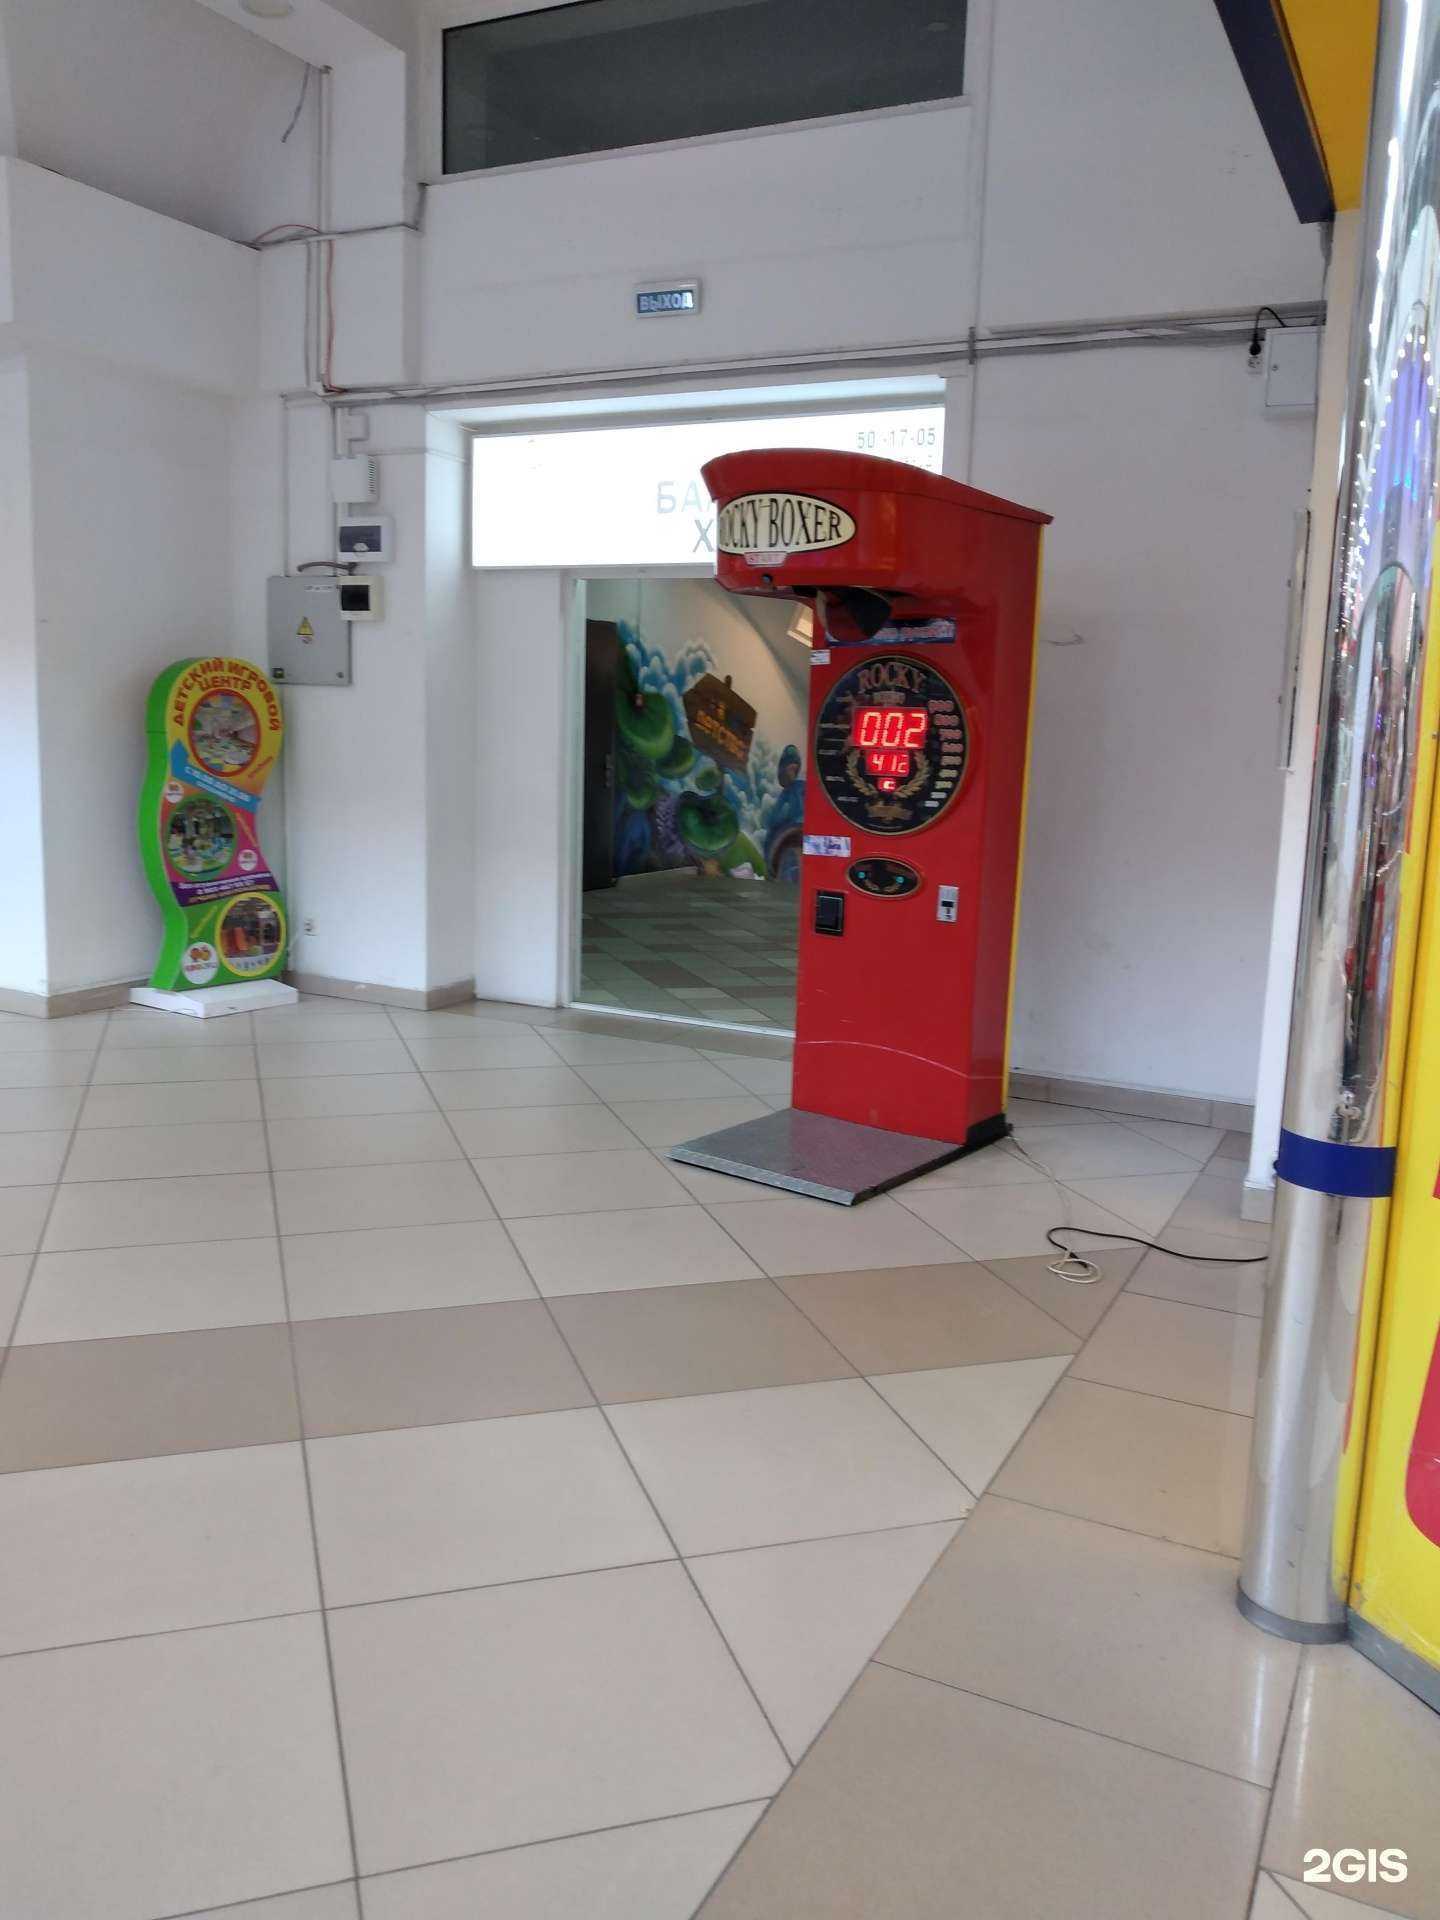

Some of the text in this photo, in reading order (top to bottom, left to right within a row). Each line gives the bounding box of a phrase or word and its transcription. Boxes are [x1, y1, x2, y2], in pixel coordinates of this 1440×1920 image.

[640, 292, 693, 311] ВЫХОД
[769, 498, 842, 548] BOXER
[173, 657, 281, 731] ДЕТСКИЙ ИГРОВОЙ
[200, 676, 250, 692] ЦЕНТР
[857, 661, 926, 694] ROCKY
[860, 711, 926, 747] 002
